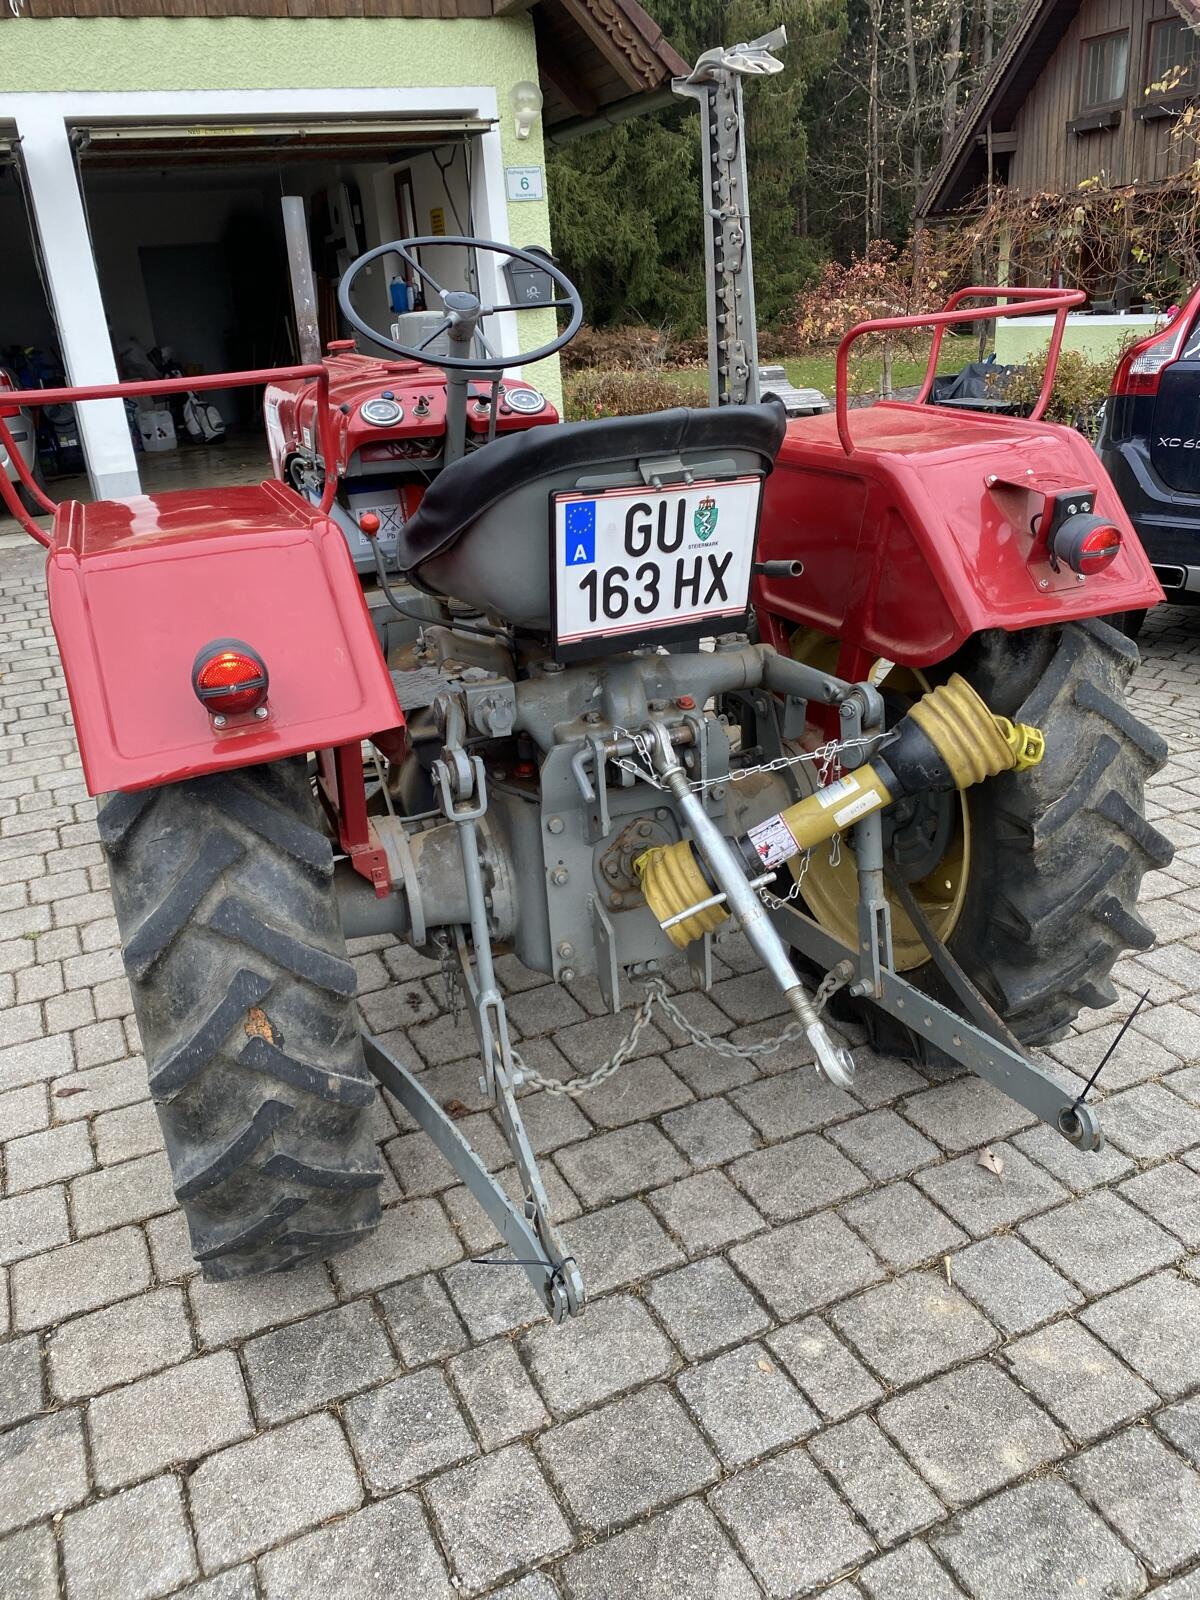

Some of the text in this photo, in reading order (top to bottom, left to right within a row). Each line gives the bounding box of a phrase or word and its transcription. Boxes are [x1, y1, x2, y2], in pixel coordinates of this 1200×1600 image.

[520, 177, 530, 190] 6
[624, 498, 686, 557] GU
[573, 544, 587, 562] A
[688, 540, 719, 550] STEIERMARK
[579, 551, 733, 621] 163 HX
